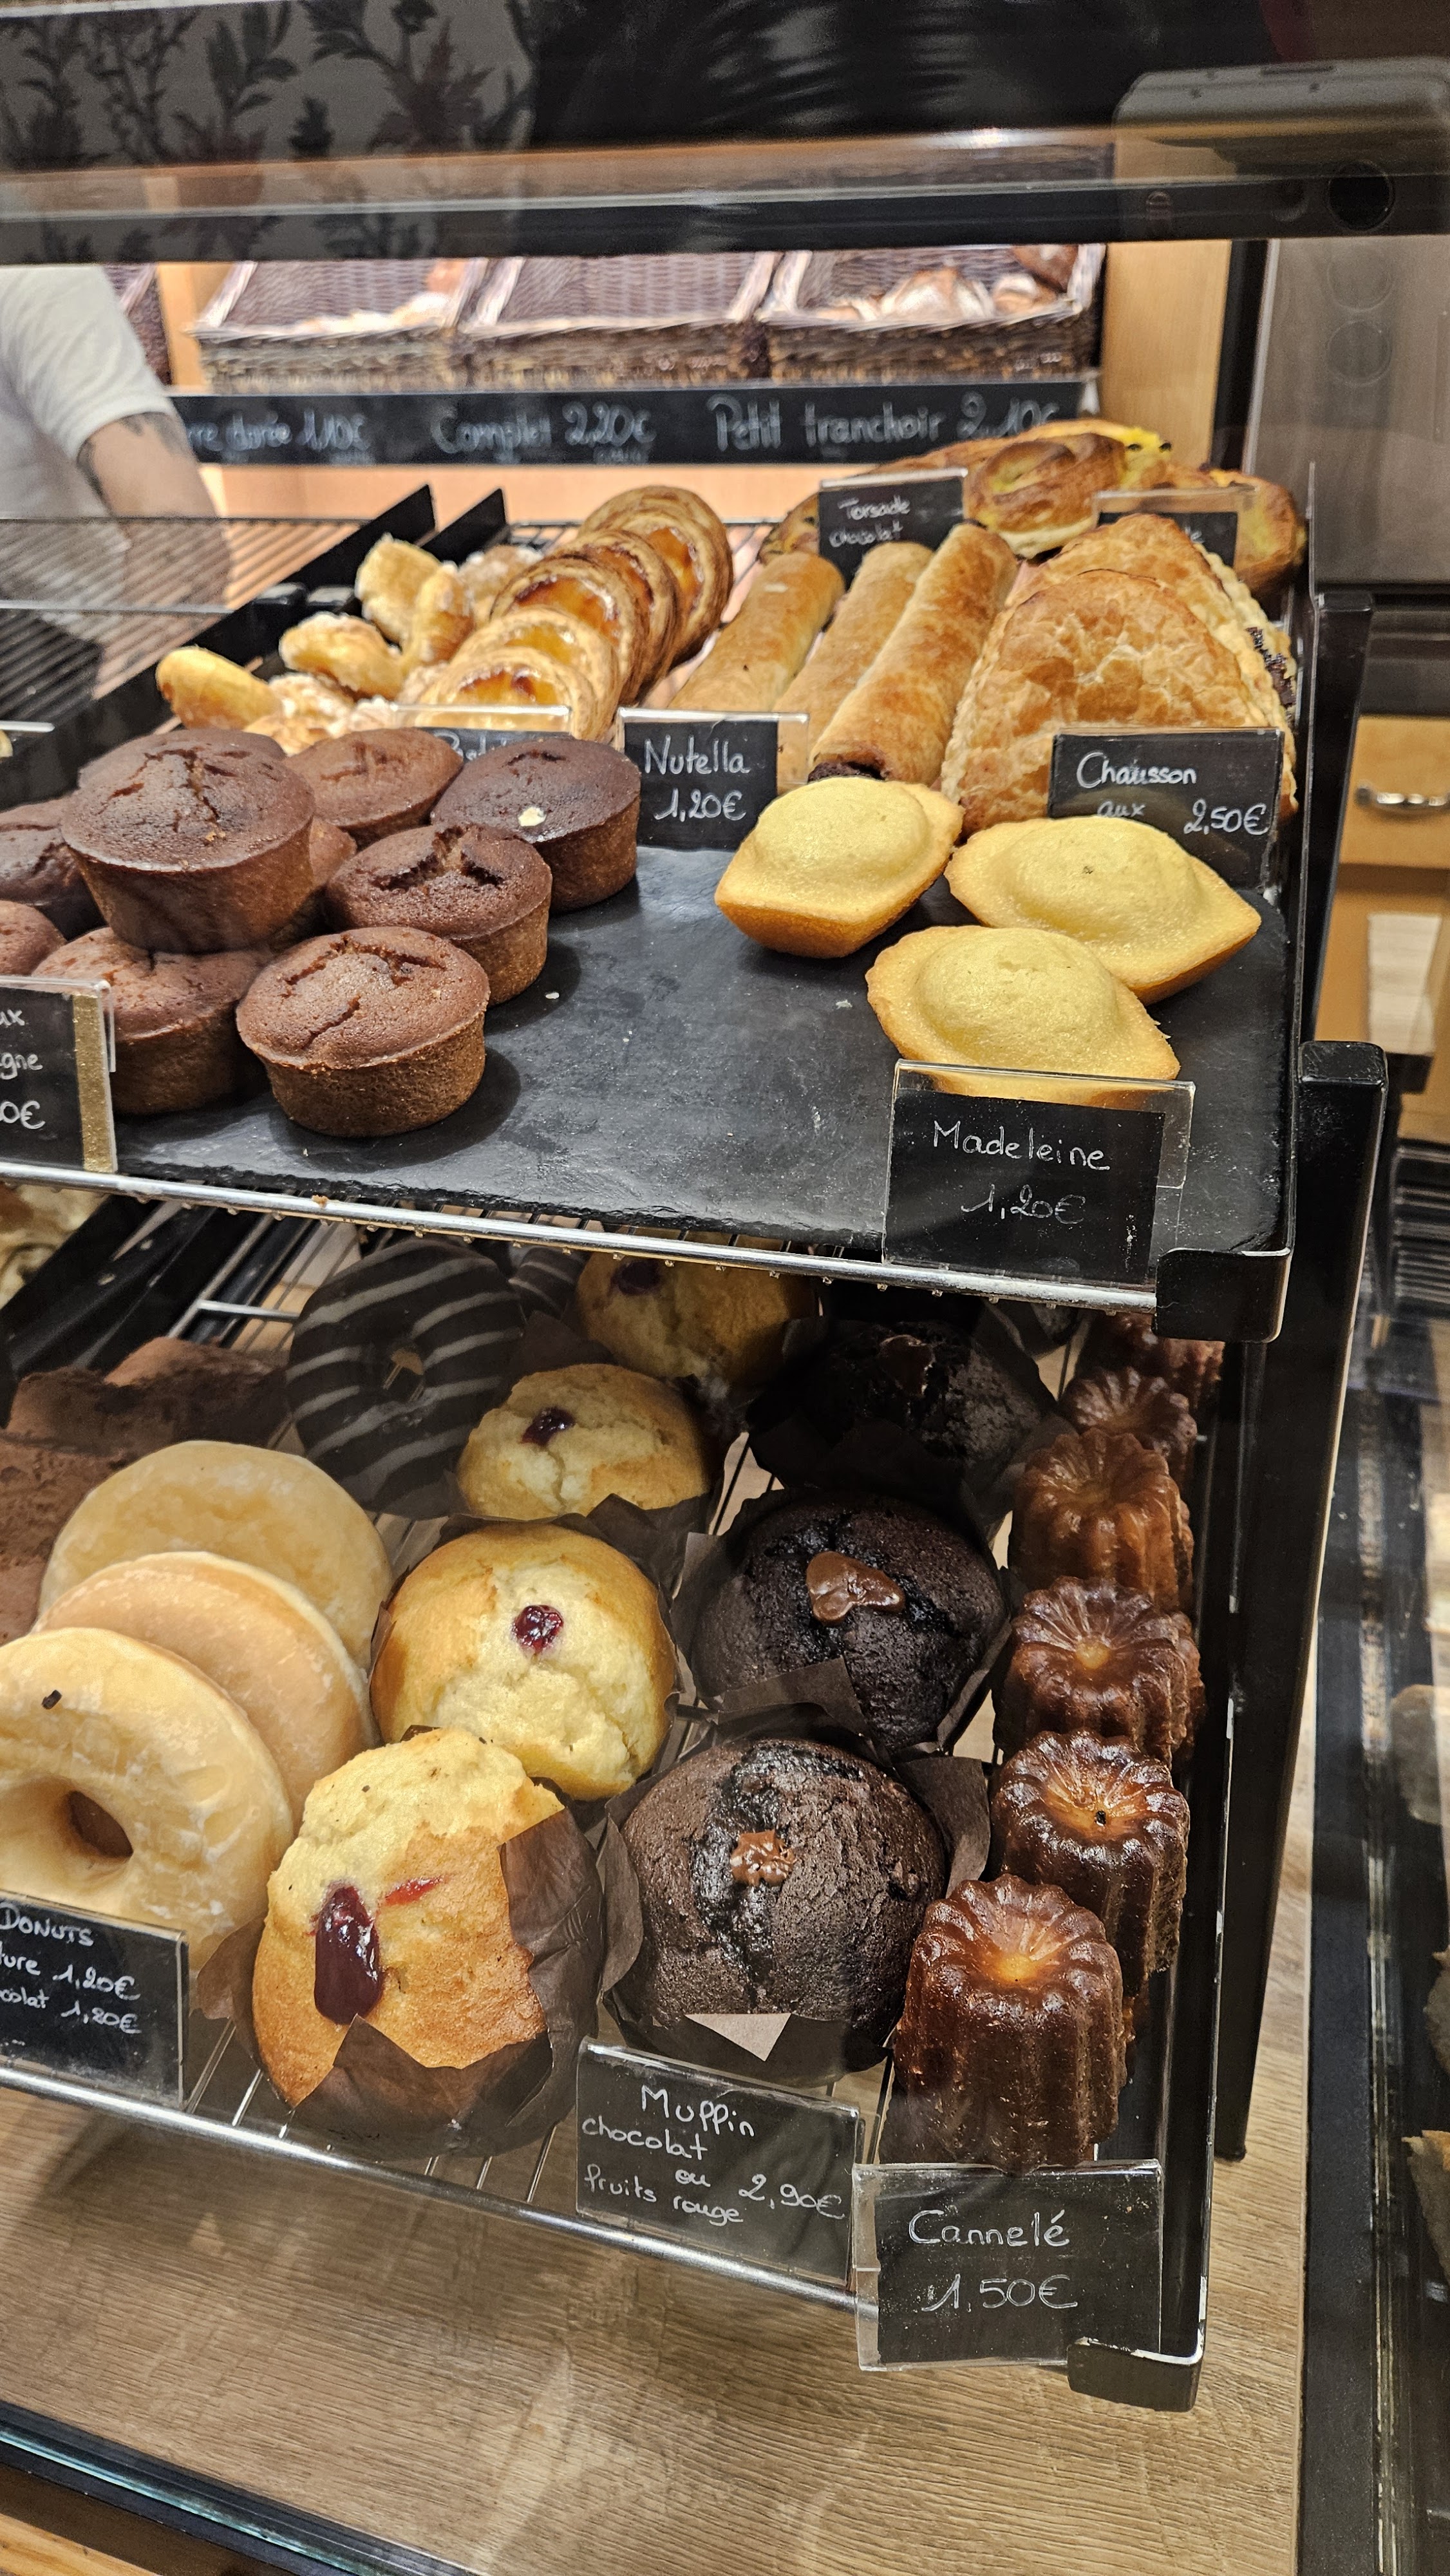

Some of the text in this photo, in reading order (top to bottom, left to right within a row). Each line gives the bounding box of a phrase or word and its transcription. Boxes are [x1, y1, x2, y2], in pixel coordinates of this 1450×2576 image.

[707, 393, 782, 451] Petit
[802, 401, 945, 446] tranchoir
[838, 495, 910, 520] Torsade
[645, 735, 750, 774] Nutella
[1076, 751, 1197, 789] Chausson
[654, 788, 746, 822] 1,20€
[1183, 798, 1269, 835] 2,50€
[0, 1052, 44, 1080] gne
[0, 1100, 46, 1130] 0€
[932, 1119, 1111, 1171] Madeleine
[960, 1183, 1086, 1225] 1,20€
[581, 2115, 708, 2161] chocolat
[675, 2168, 711, 2188] ou
[673, 2195, 744, 2227] rouge
[738, 2173, 846, 2220] 2,90€
[908, 2208, 1070, 2247] Cannelé
